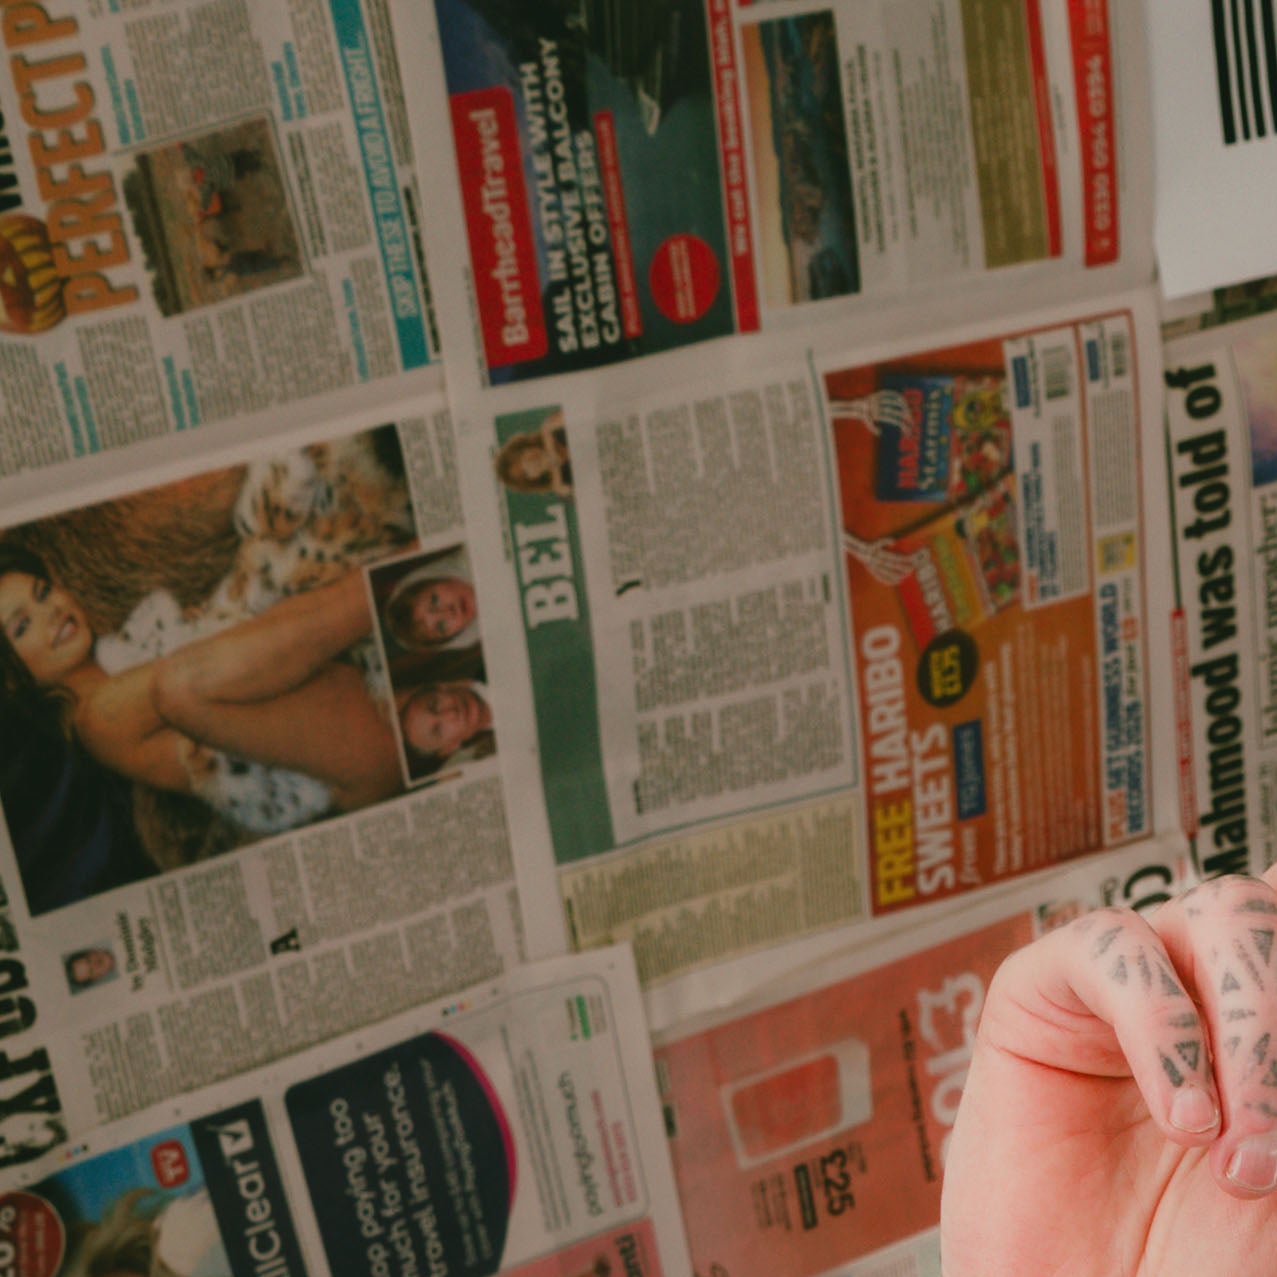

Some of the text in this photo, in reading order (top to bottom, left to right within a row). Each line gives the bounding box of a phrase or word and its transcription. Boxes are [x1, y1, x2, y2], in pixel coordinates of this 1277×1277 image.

[13, 54, 135, 313] PERFECT
[519, 62, 578, 352] SAIL IN STYLE WITH
[540, 39, 599, 347] EXCLUSIVE BALCONY
[575, 131, 606, 244] OFFERS
[593, 252, 620, 343] CABIN
[515, 504, 577, 625] BEL
[1165, 364, 1248, 875] Mahmood was told of
[862, 626, 914, 903] FREE HARIBO
[910, 724, 954, 892] SWEETS
[329, 1097, 355, 1146] too
[362, 1113, 397, 1173] your
[383, 1070, 428, 1202] insurance.
[342, 1146, 383, 1237] paying
[379, 1179, 402, 1217] for
